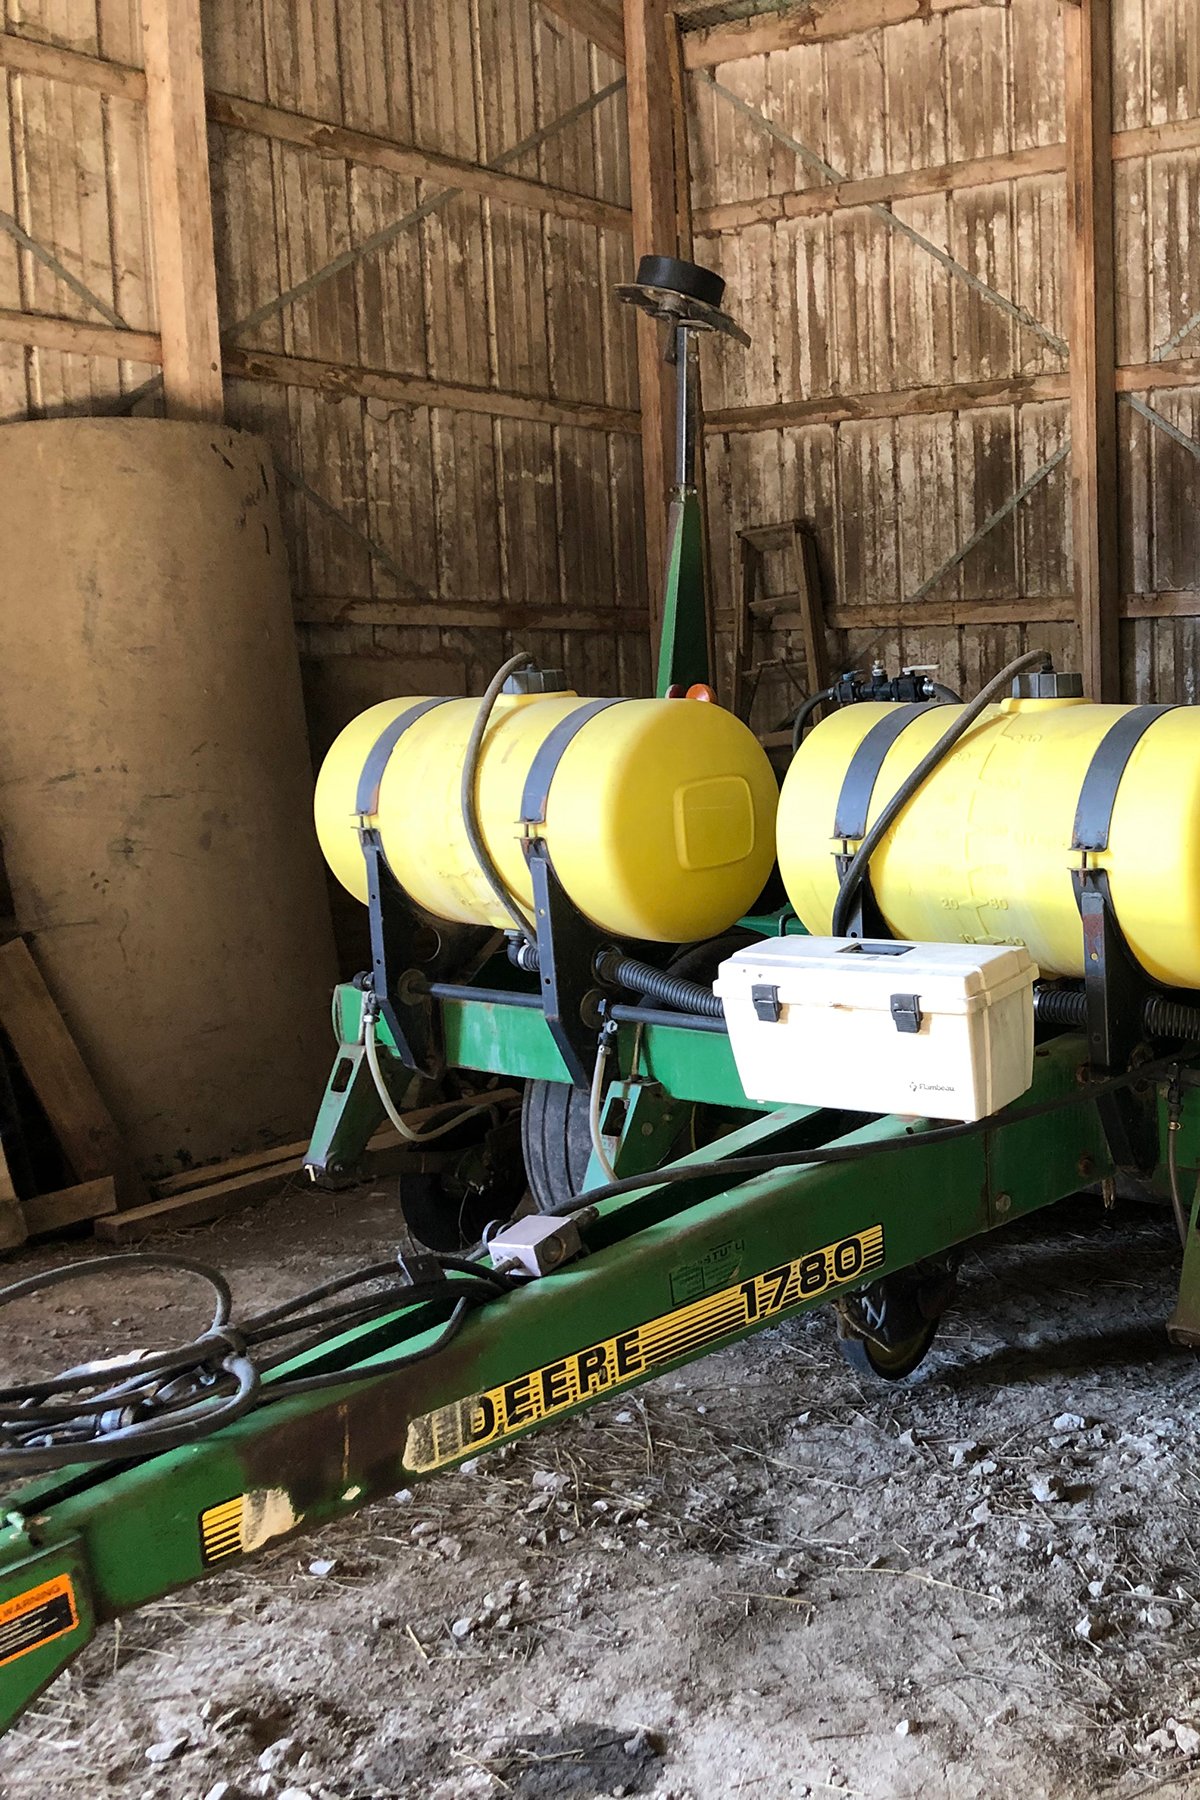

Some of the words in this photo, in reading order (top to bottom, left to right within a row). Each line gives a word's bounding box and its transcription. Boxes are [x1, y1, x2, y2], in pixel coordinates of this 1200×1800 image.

[941, 897, 960, 911] 20
[460, 1330, 645, 1447] DEERE
[736, 1236, 864, 1320] 1780
[3, 1583, 61, 1617] WARNING
